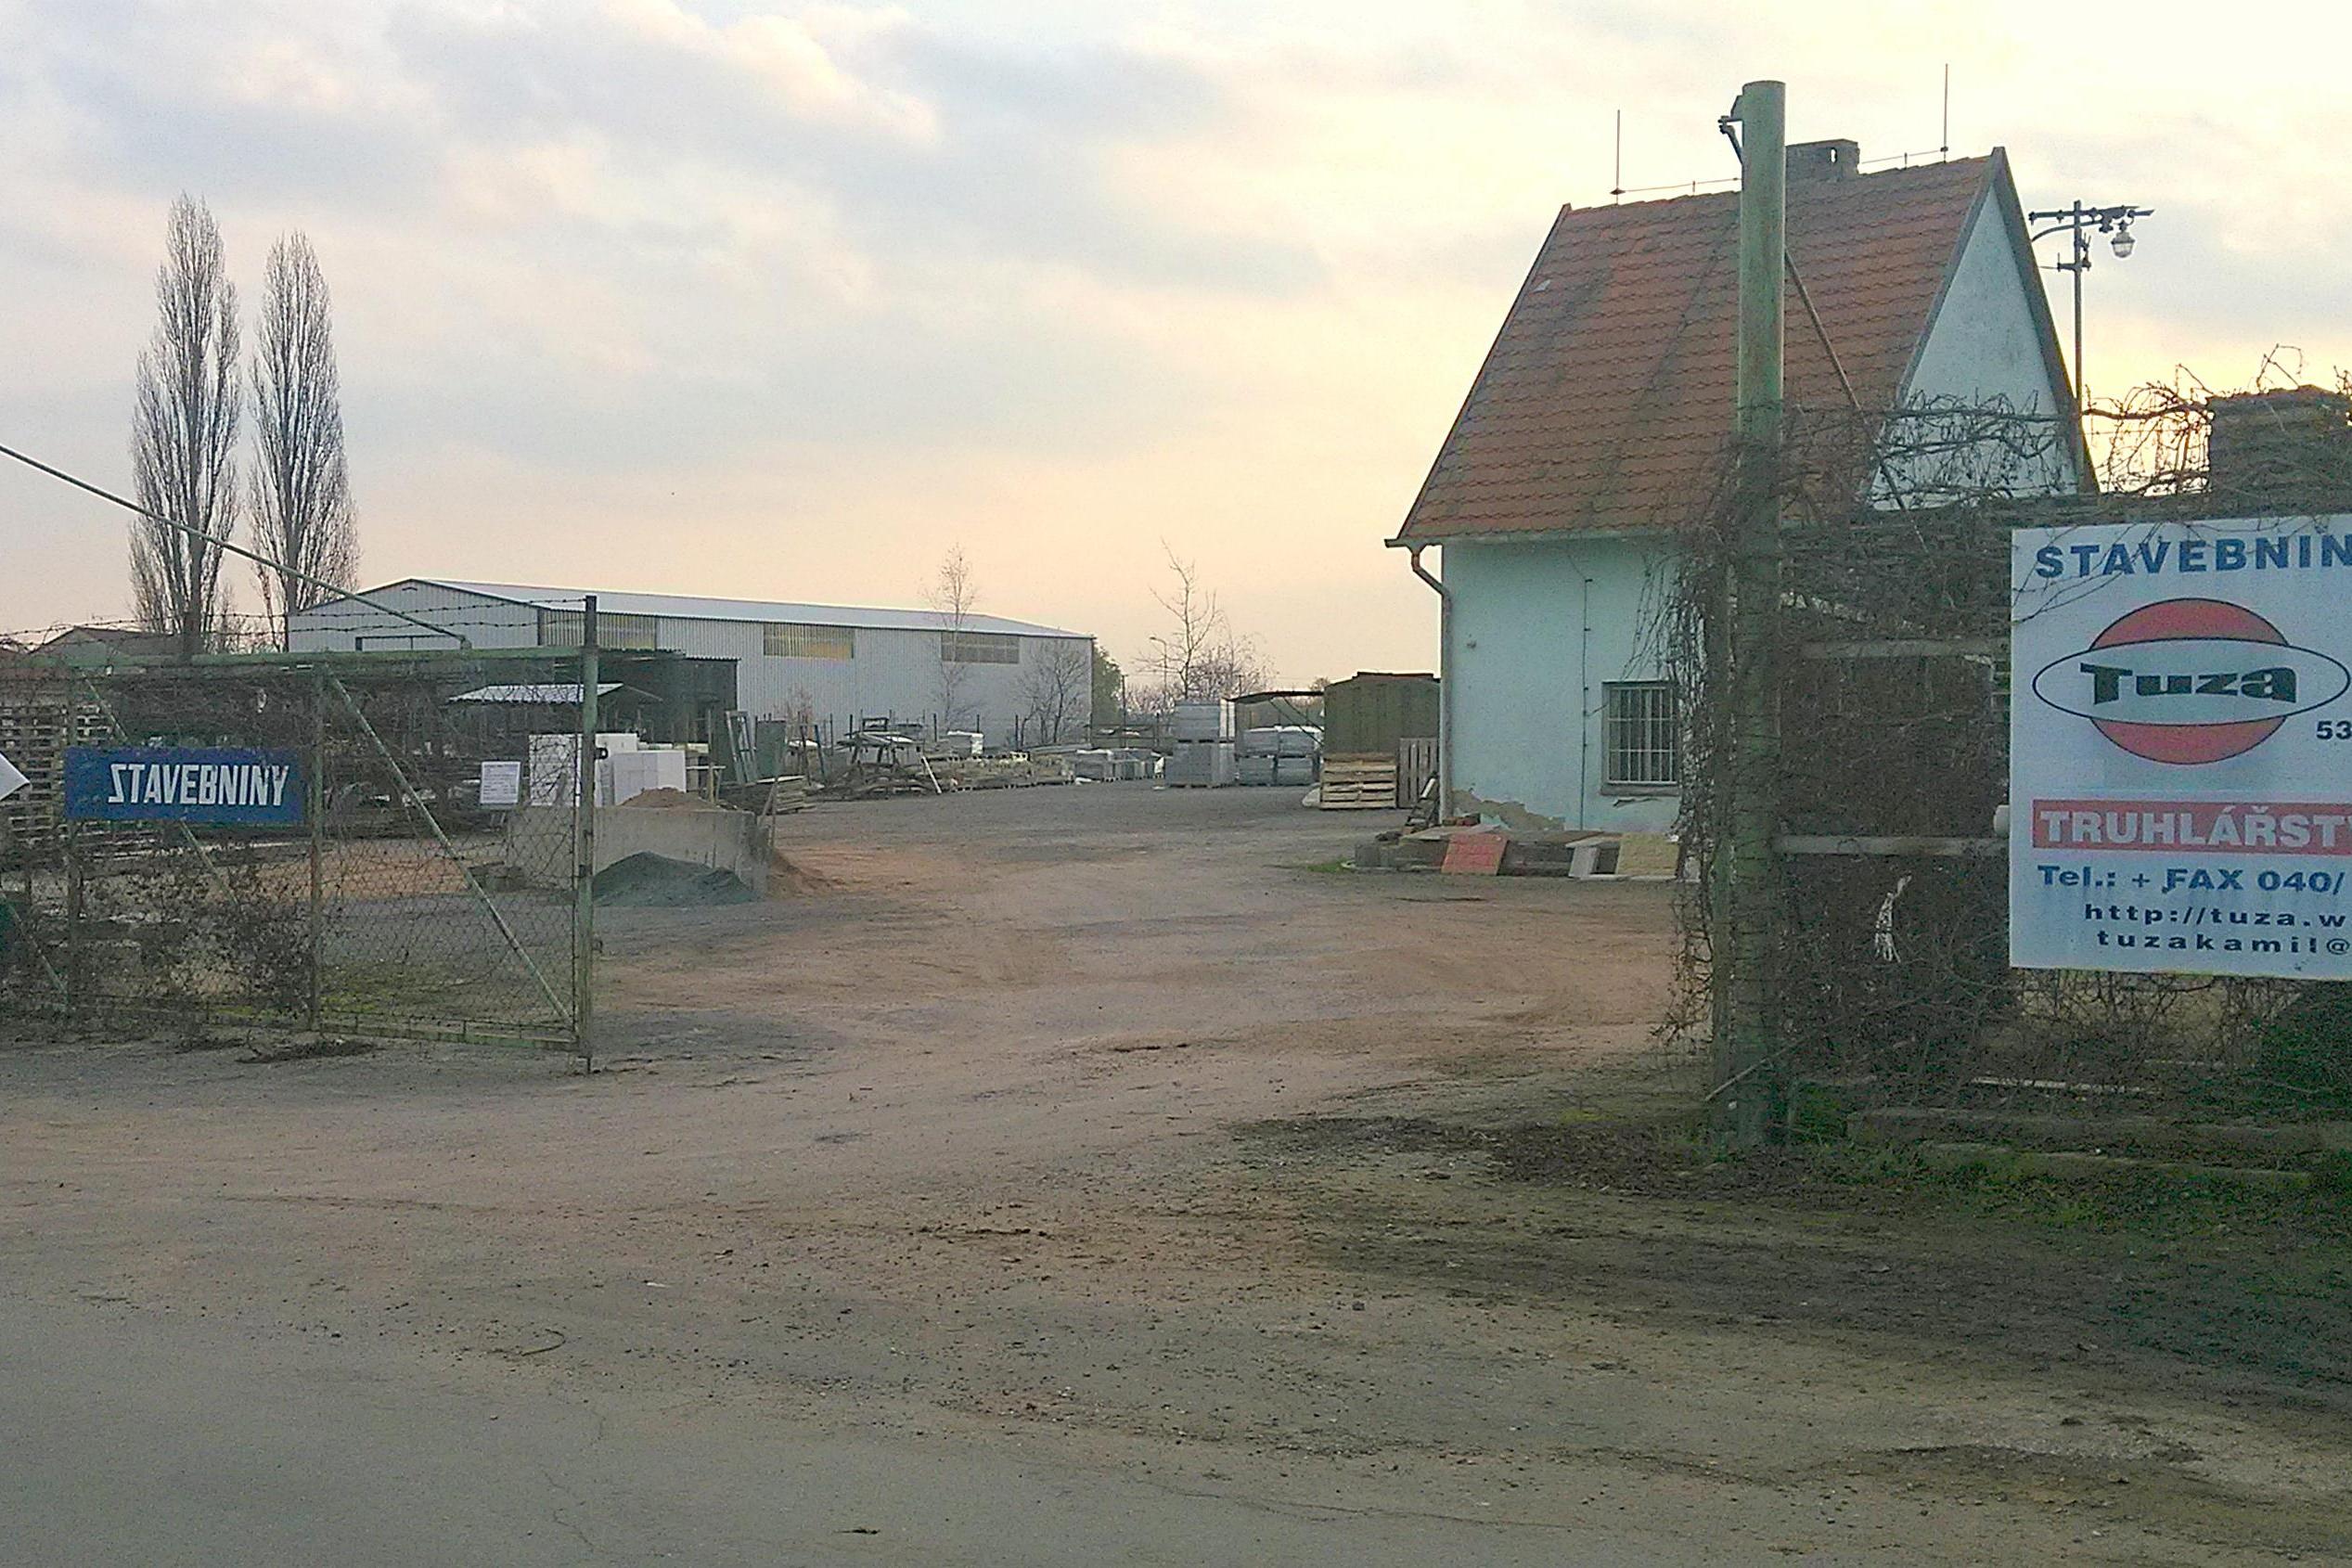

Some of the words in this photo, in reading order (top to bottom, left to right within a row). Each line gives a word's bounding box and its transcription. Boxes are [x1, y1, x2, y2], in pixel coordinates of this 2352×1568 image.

[2035, 533, 2352, 579] STAVEBNIN
[2080, 662, 2297, 705] Tuza
[2316, 720, 2352, 740] 53
[108, 763, 289, 806] STAVEBNINY
[2037, 865, 2116, 887] Tel.:
[2257, 871, 2346, 895] 040/
